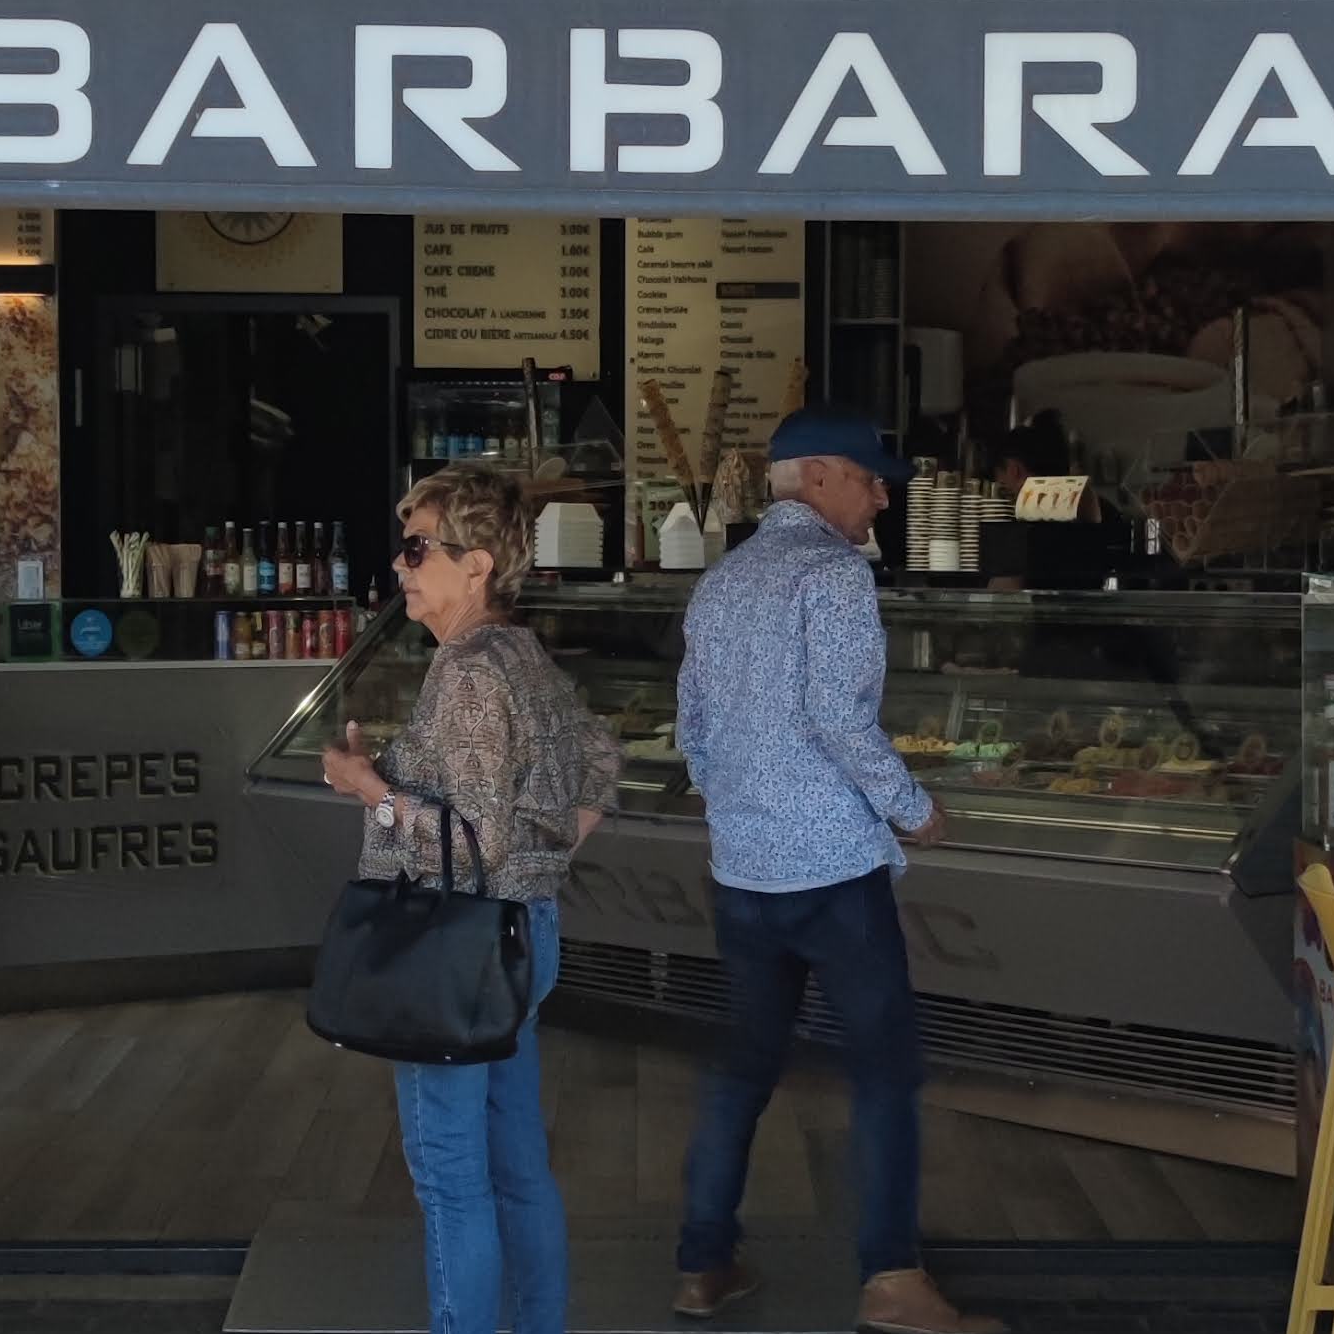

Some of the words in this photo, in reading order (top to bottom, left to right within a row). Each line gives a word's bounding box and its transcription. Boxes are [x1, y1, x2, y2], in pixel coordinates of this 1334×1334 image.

[424, 224, 445, 235] JUS
[451, 224, 465, 235] DE
[471, 224, 510, 235] FRUITS
[637, 275, 671, 284] Chocolat
[637, 291, 667, 299] Cookies
[424, 307, 487, 319] CHOCOLAT
[424, 328, 459, 340] CIDRE
[461, 328, 477, 340] OU
[560, 328, 589, 340] 4.50€
